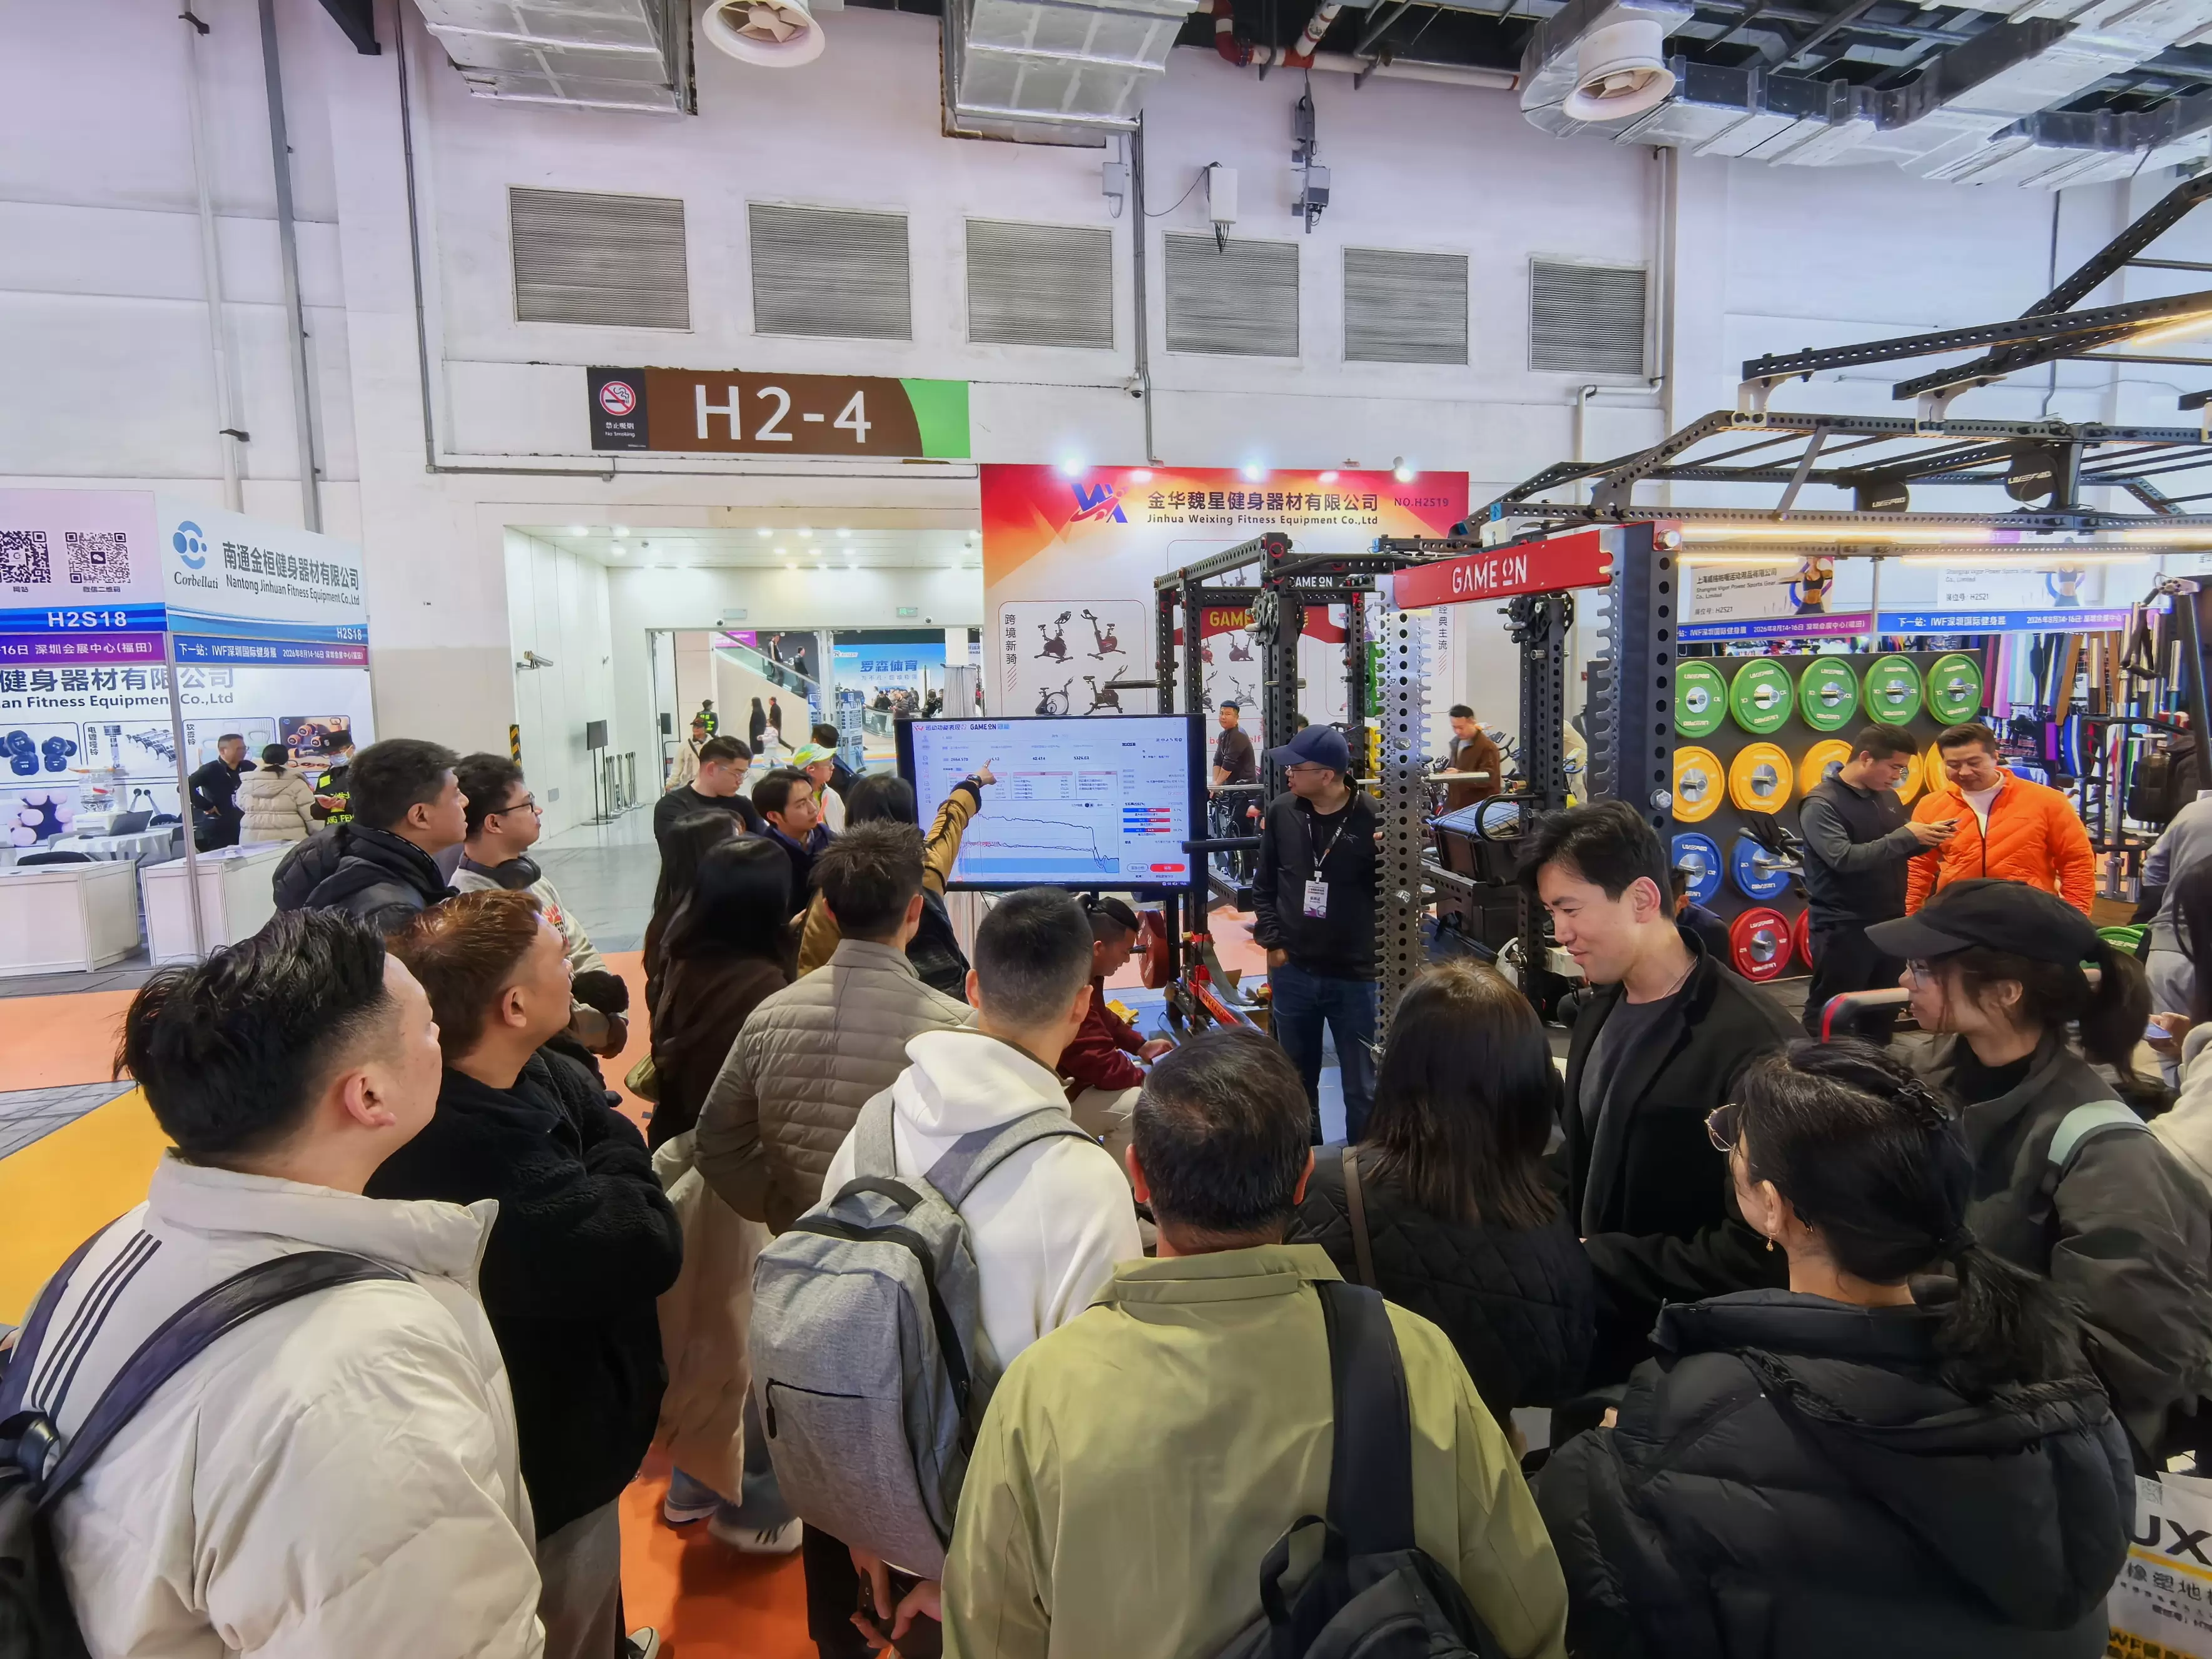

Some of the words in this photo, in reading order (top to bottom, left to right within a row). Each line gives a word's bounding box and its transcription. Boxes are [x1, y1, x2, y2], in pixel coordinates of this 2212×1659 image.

[695, 384, 872, 444] H2-4
[1147, 490, 1378, 512] 金华魏星健身器材有限公司
[1147, 514, 1184, 524] Jinhua
[1189, 514, 1233, 525] Weixing
[1238, 514, 1276, 524] Fitness
[1280, 515, 1337, 526] Equipment
[1341, 515, 1378, 525] Co.,Ltd
[222, 541, 359, 591] 南通金桓健身器材有限公司
[174, 571, 218, 589] Corbellati
[1319, 576, 1333, 587] ON
[1452, 559, 1498, 594] GAME
[1503, 554, 1528, 586] ON
[226, 574, 259, 594] Nantong
[260, 579, 287, 595] Jinhuan
[287, 584, 309, 598] Fitness
[310, 587, 340, 606] Equipment
[48, 611, 127, 627] H2S18
[1210, 611, 1251, 626] GAME
[337, 627, 362, 641] H2S18
[1438, 605, 1448, 650] 经典主流
[1005, 614, 1017, 664] 跨境新骑
[35, 642, 153, 655] 深圳会展中心(福田)
[283, 649, 325, 659] 2026年8月14-16日
[860, 659, 918, 672] 罗森体育
[0, 698, 22, 709] an
[28, 696, 85, 708] Fitness
[90, 694, 169, 709] Equipmen
[180, 692, 234, 705] Co.,Ltd
